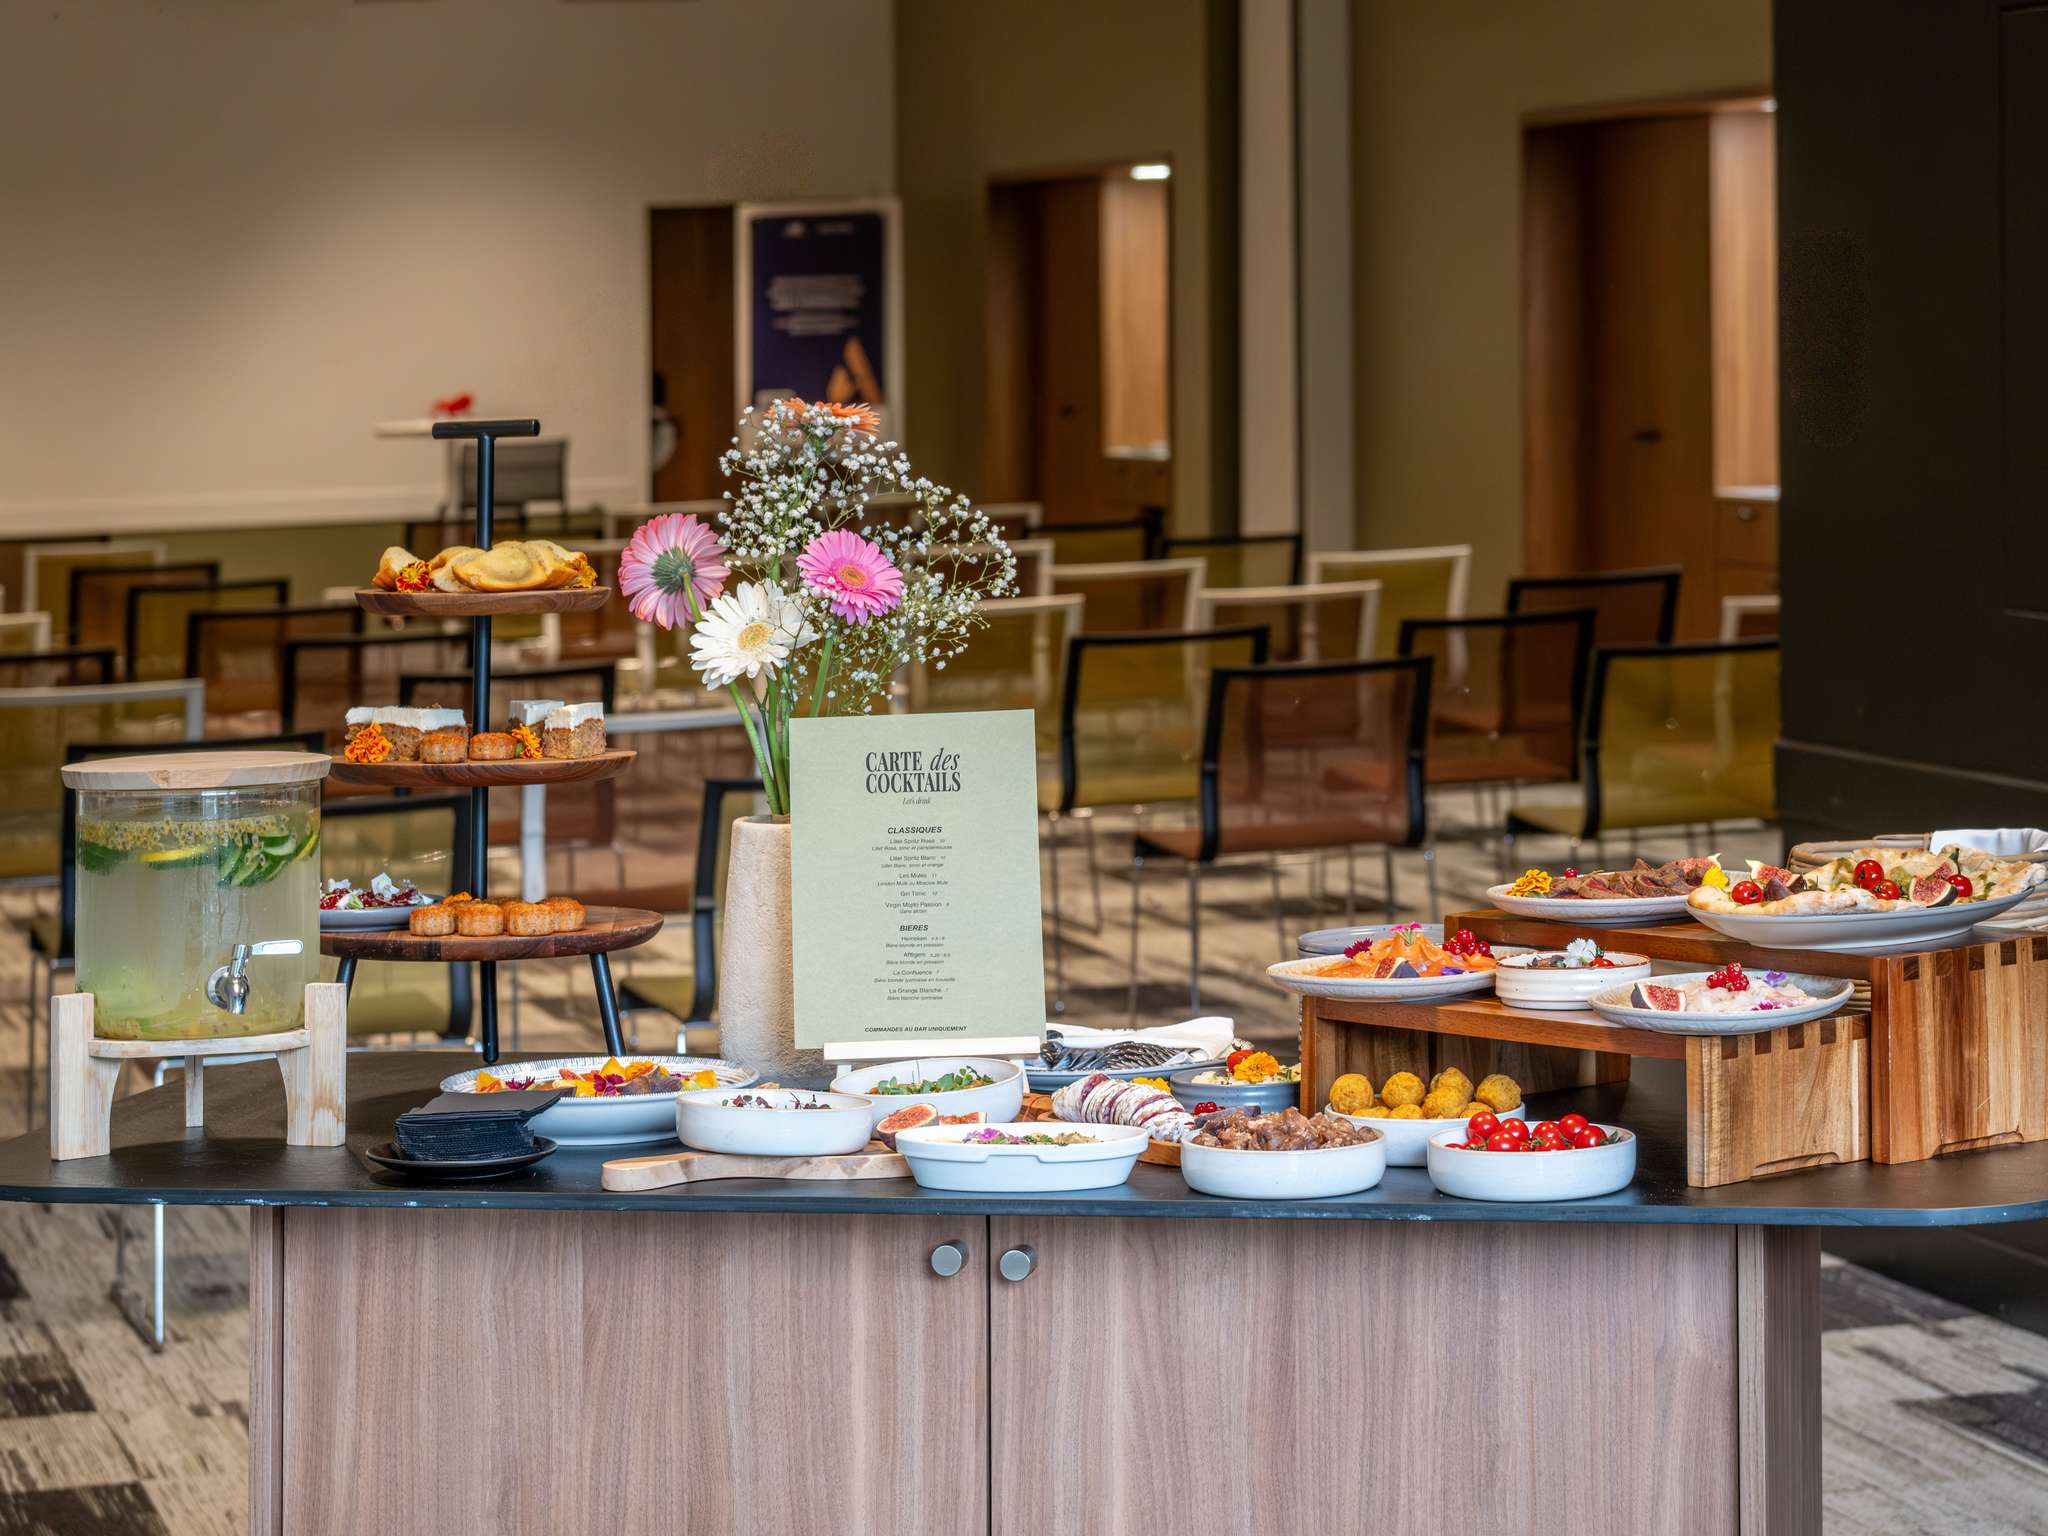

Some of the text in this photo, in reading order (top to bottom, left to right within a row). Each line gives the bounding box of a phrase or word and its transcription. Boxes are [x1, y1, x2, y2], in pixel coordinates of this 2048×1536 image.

[866, 747, 960, 772] CARTE des
[866, 772, 961, 793] COCKTAILS
